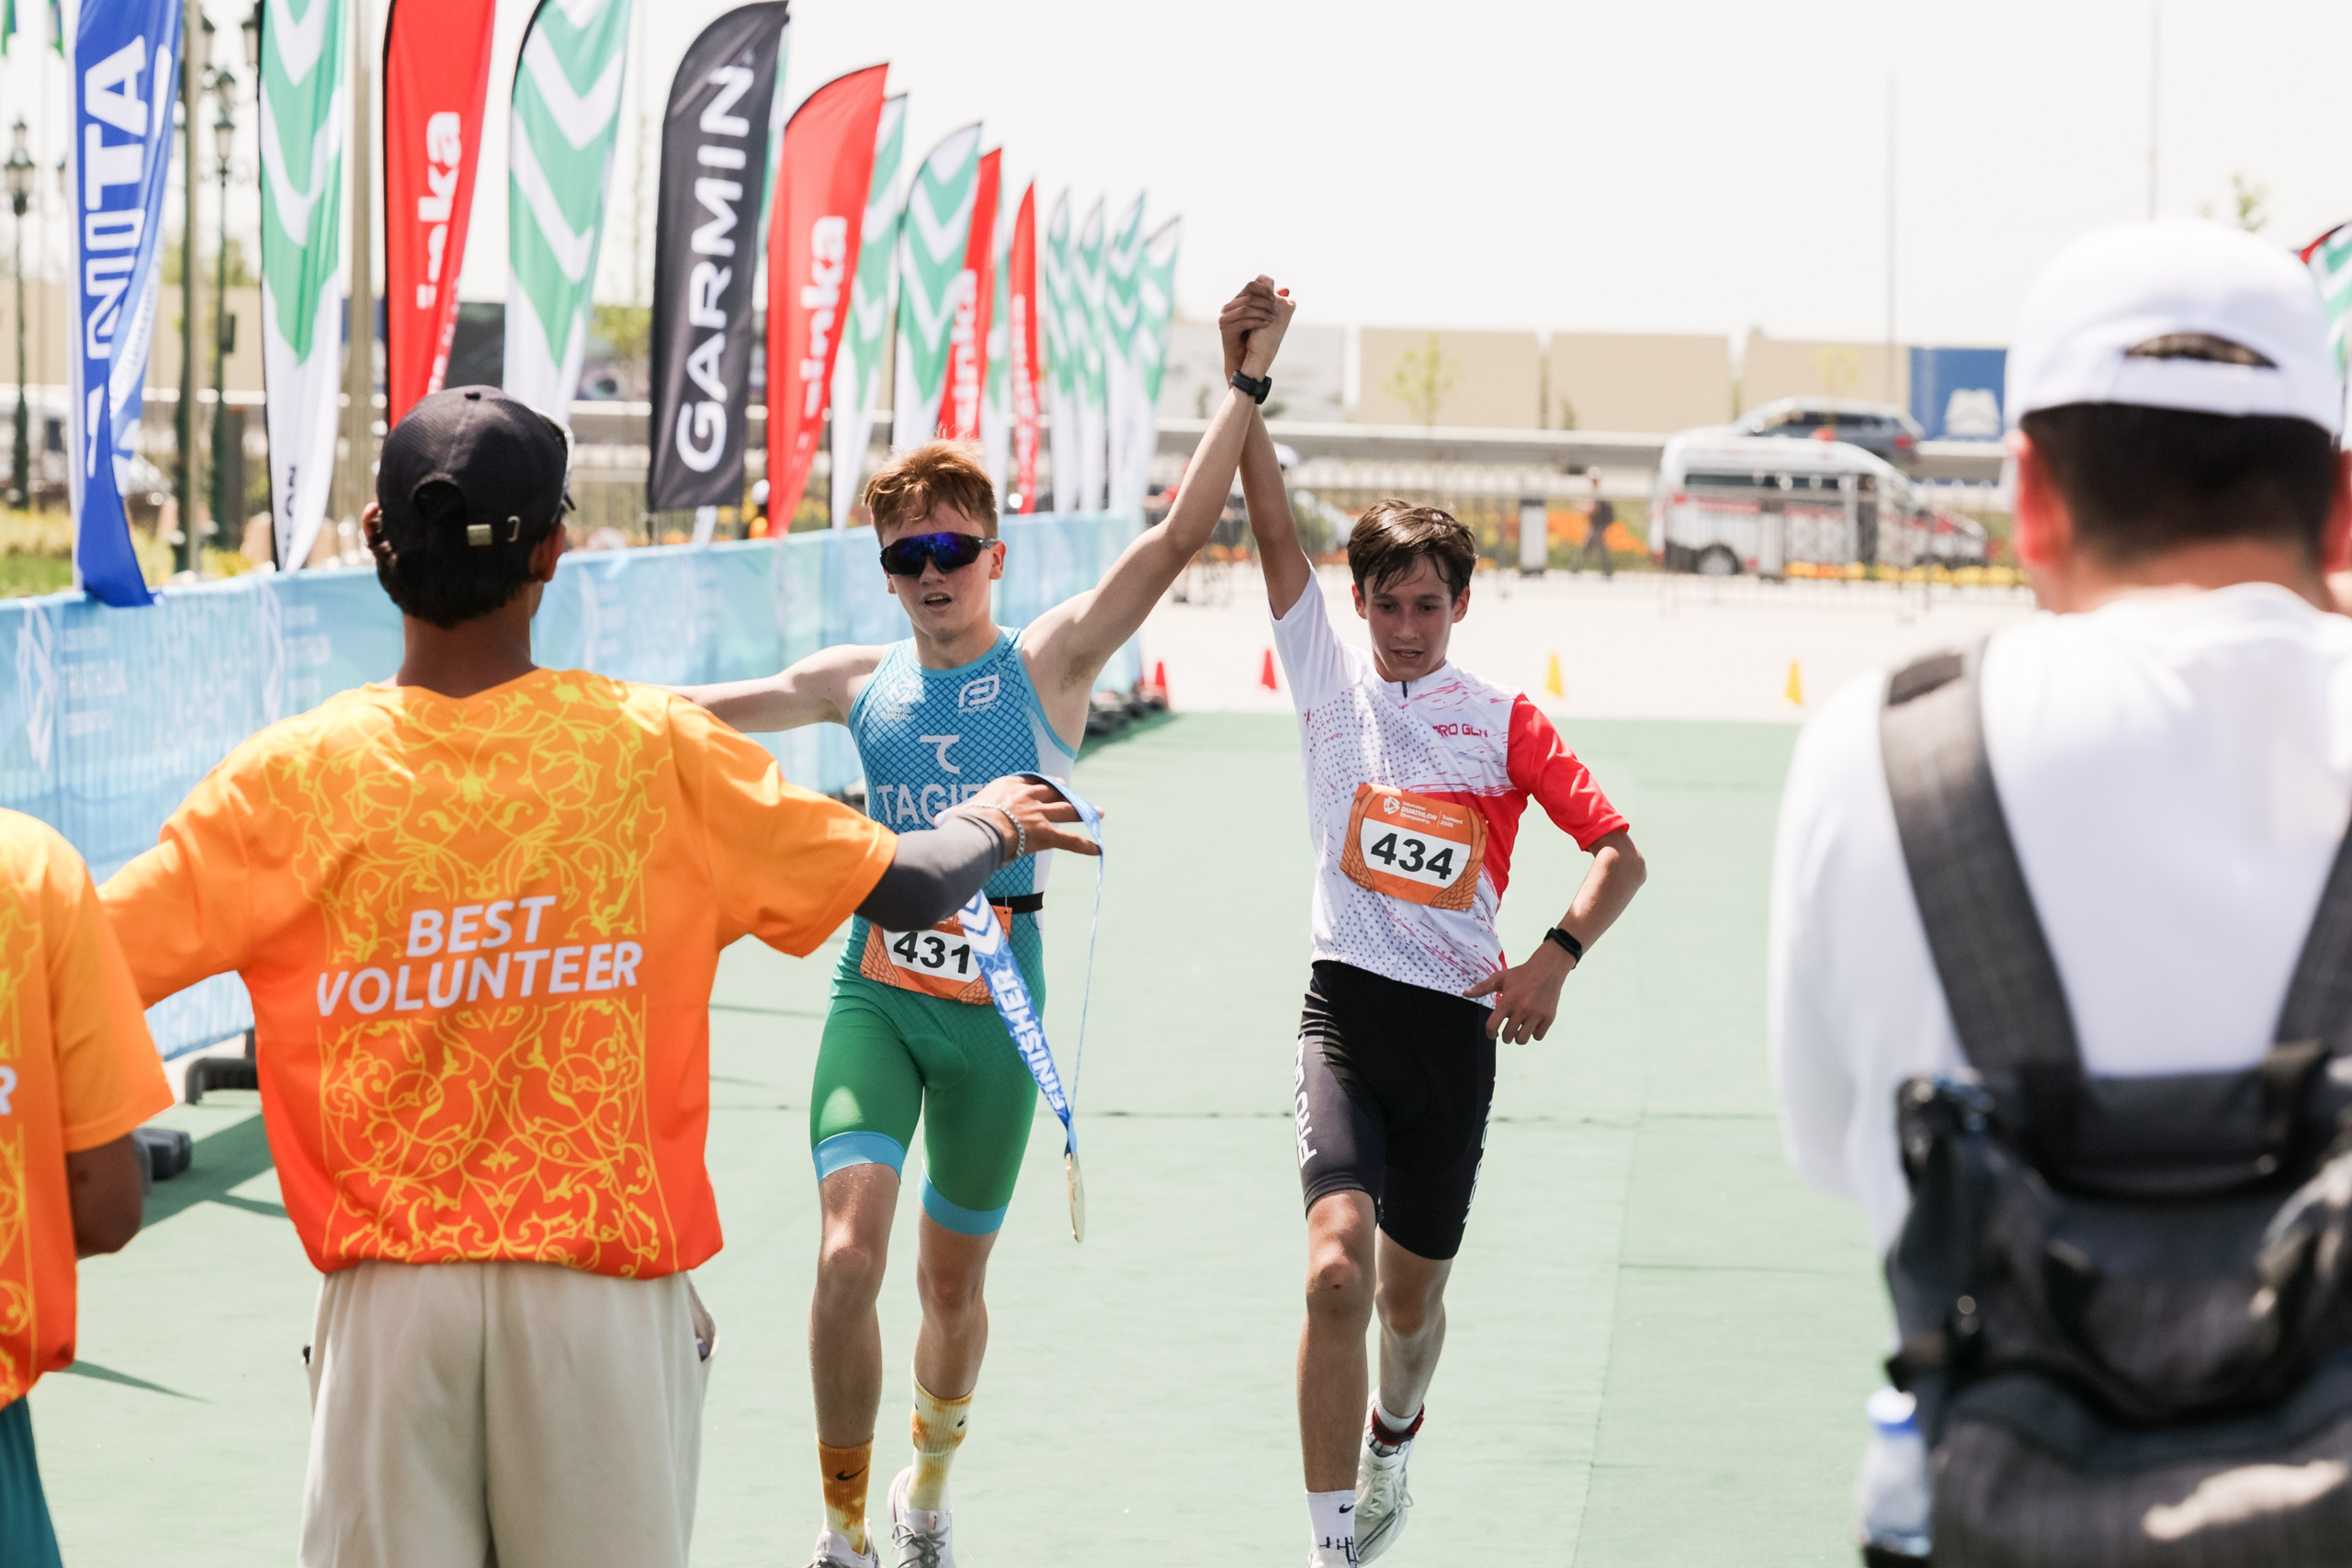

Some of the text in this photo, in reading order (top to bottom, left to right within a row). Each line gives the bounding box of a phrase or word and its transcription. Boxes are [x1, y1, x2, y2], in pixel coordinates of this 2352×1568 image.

[676, 65, 754, 473] GARMIN
[1401, 807, 1438, 820] DUATHLON
[1370, 831, 1454, 880] 434
[406, 896, 556, 957] BEST
[892, 931, 972, 976] 431
[316, 942, 643, 1016] VOLUNTEER
[990, 966, 1067, 1111] FINISHER
